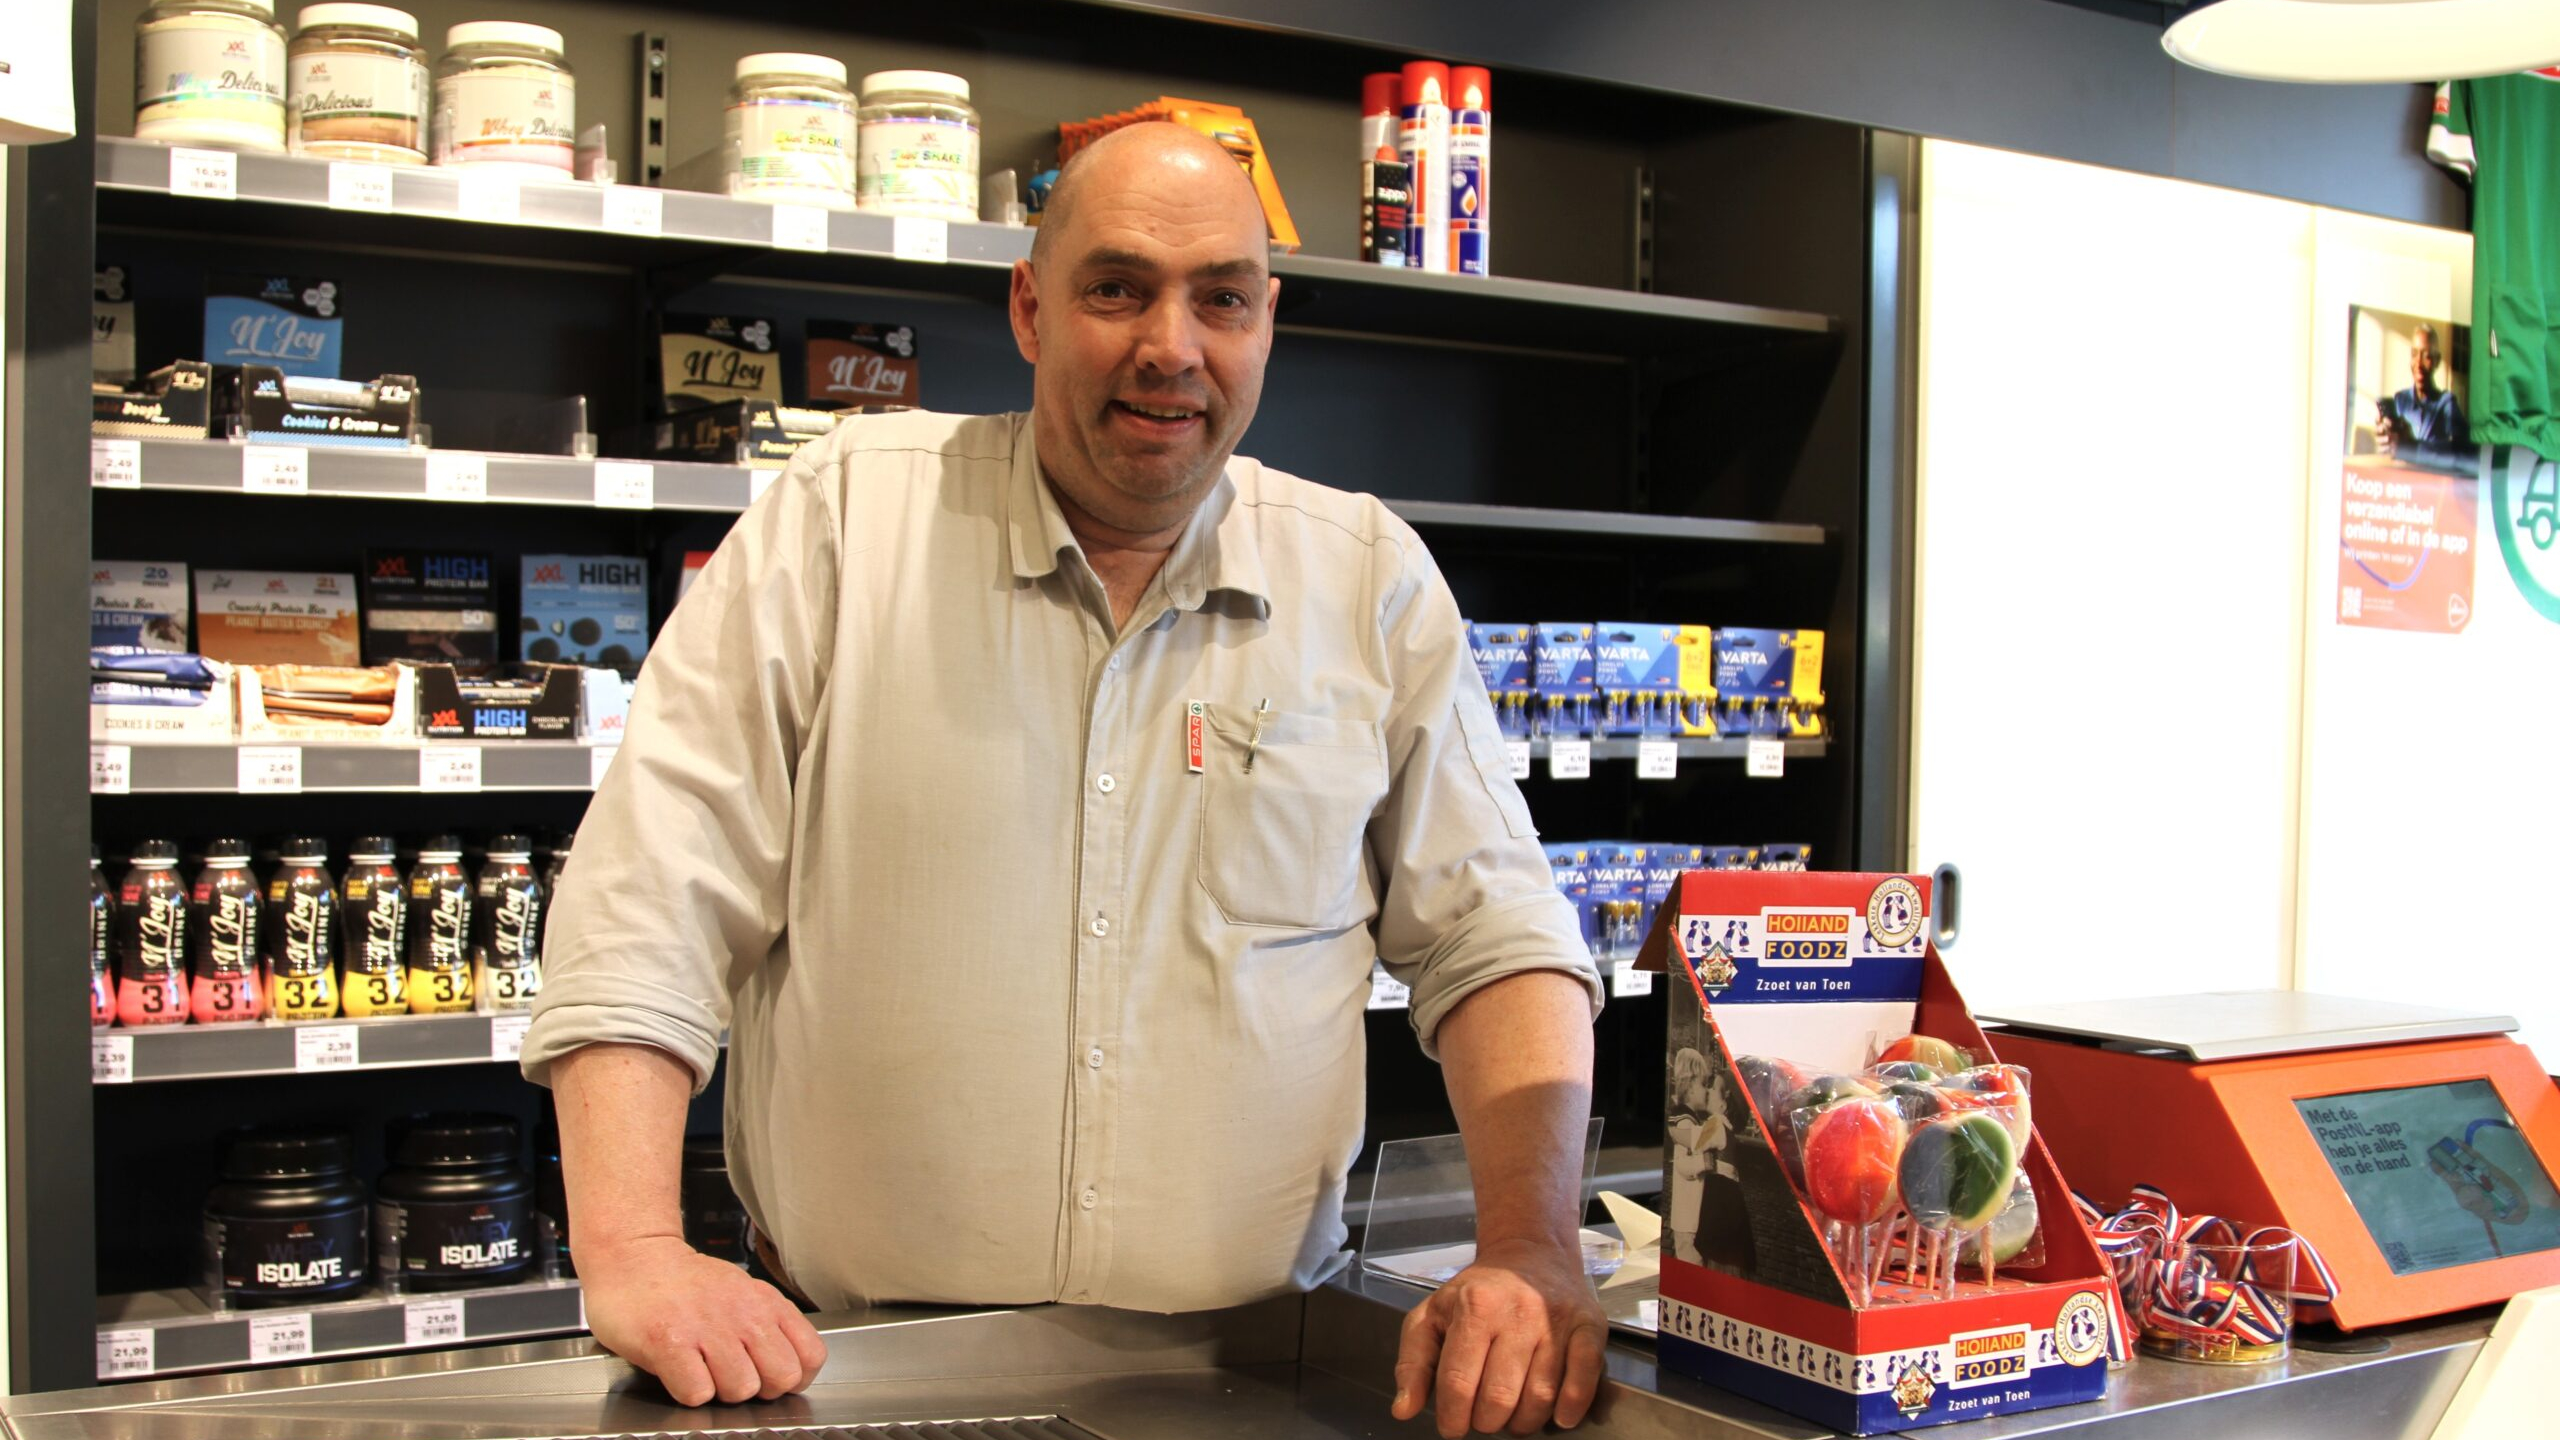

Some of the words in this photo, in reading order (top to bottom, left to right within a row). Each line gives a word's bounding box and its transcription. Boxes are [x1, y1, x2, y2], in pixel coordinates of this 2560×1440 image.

[217, 70, 280, 95] Delicius
[302, 90, 373, 113] Delicious
[1377, 186, 1407, 203] zippo
[226, 314, 326, 360] N'Joy
[682, 350, 766, 390] N'Joy
[826, 354, 907, 395] N'Joy
[281, 414, 329, 429] Cookies
[342, 417, 380, 432] Cream
[2347, 474, 2383, 501] Koop
[2387, 482, 2412, 501] een
[2347, 501, 2434, 525] verzendlabel
[2346, 523, 2389, 544] online
[2392, 526, 2406, 545] of
[2408, 526, 2422, 547] in
[2424, 530, 2440, 549] de
[2443, 534, 2468, 556] app
[376, 556, 410, 577] XXL
[423, 556, 489, 579] HIGH
[532, 562, 566, 585] XXL
[578, 563, 641, 585] HIGH
[1472, 647, 1528, 662] VARTA
[1538, 646, 1593, 661] VARTA
[1597, 646, 1650, 661] VARTA
[1721, 650, 1768, 666] VARTA
[432, 709, 461, 726] XXL
[473, 708, 528, 728] HIGH
[599, 715, 624, 730] XXL
[1191, 716, 1201, 757] SPAR
[1555, 870, 1587, 884] RTA
[1593, 868, 1645, 882] VARTA
[1650, 868, 1681, 881] VAR
[1760, 861, 1808, 872] VARTA
[1873, 881, 1911, 902] Hollandse
[140, 894, 174, 967] N'Joy
[174, 906, 186, 959] DRINK
[209, 893, 245, 967] N'Joy
[245, 904, 257, 956] DRINK
[285, 891, 318, 966] N'Joy
[316, 904, 330, 956] DRINK
[367, 889, 399, 964] N'Joy
[430, 888, 462, 963] N'Joy
[494, 886, 529, 956] N'Joy
[1871, 905, 1885, 940] Lekkere
[1766, 941, 1847, 959] FOODZ
[285, 980, 330, 1009] 32
[432, 973, 472, 1003] 32
[496, 971, 538, 999] 32
[1757, 978, 1791, 992] Zzoet
[1795, 981, 1817, 991] van
[1823, 978, 1851, 991] Toen
[2307, 1107, 2338, 1125] Met
[2340, 1106, 2358, 1121] de
[2317, 1121, 2402, 1142] PostNL-app
[2327, 1142, 2355, 1160] heb
[2357, 1141, 2373, 1157] je
[2374, 1137, 2408, 1154] alles
[2339, 1161, 2355, 1177] in
[2356, 1159, 2374, 1175] de
[2376, 1154, 2412, 1172] hand
[440, 1238, 518, 1265] ISOLATE
[256, 1257, 342, 1284] ISOLATE
[426, 1314, 457, 1324] 21,99
[2059, 1295, 2093, 1325] Hollandse
[272, 1330, 305, 1341] 21,99
[2059, 1330, 2077, 1362] Lekkere
[113, 1346, 148, 1357] 21,99
[1956, 1356, 2025, 1381] FOODZ
[1948, 1398, 1979, 1412] Zzoet
[1982, 1395, 2001, 1406] van
[2005, 1390, 2031, 1402] Toen
